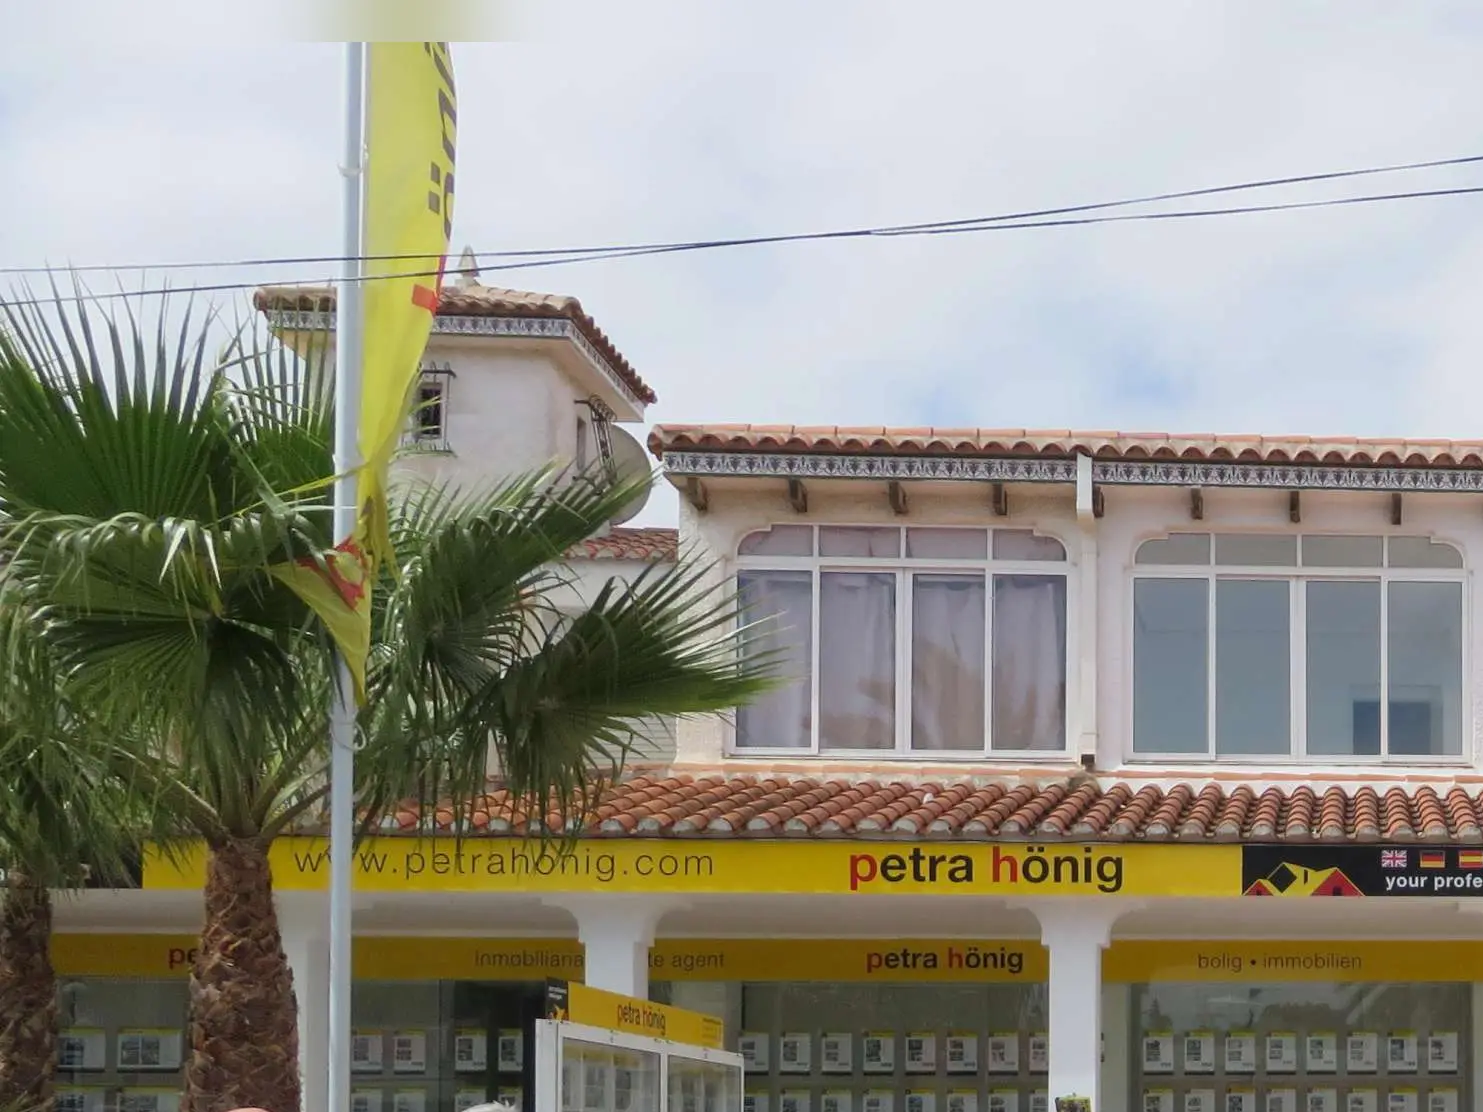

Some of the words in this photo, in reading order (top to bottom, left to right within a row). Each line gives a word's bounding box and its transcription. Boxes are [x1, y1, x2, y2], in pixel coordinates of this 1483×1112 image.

[849, 847, 974, 890] petra
[992, 846, 1124, 893] hönig
[1385, 876, 1428, 891] your
[671, 953, 725, 972] agent
[866, 947, 938, 974] petra
[948, 946, 1024, 974] hönig
[1197, 952, 1243, 973] bolig
[1263, 952, 1363, 969] immobilien
[617, 1001, 641, 1028] petra
[642, 1003, 667, 1036] hönig
